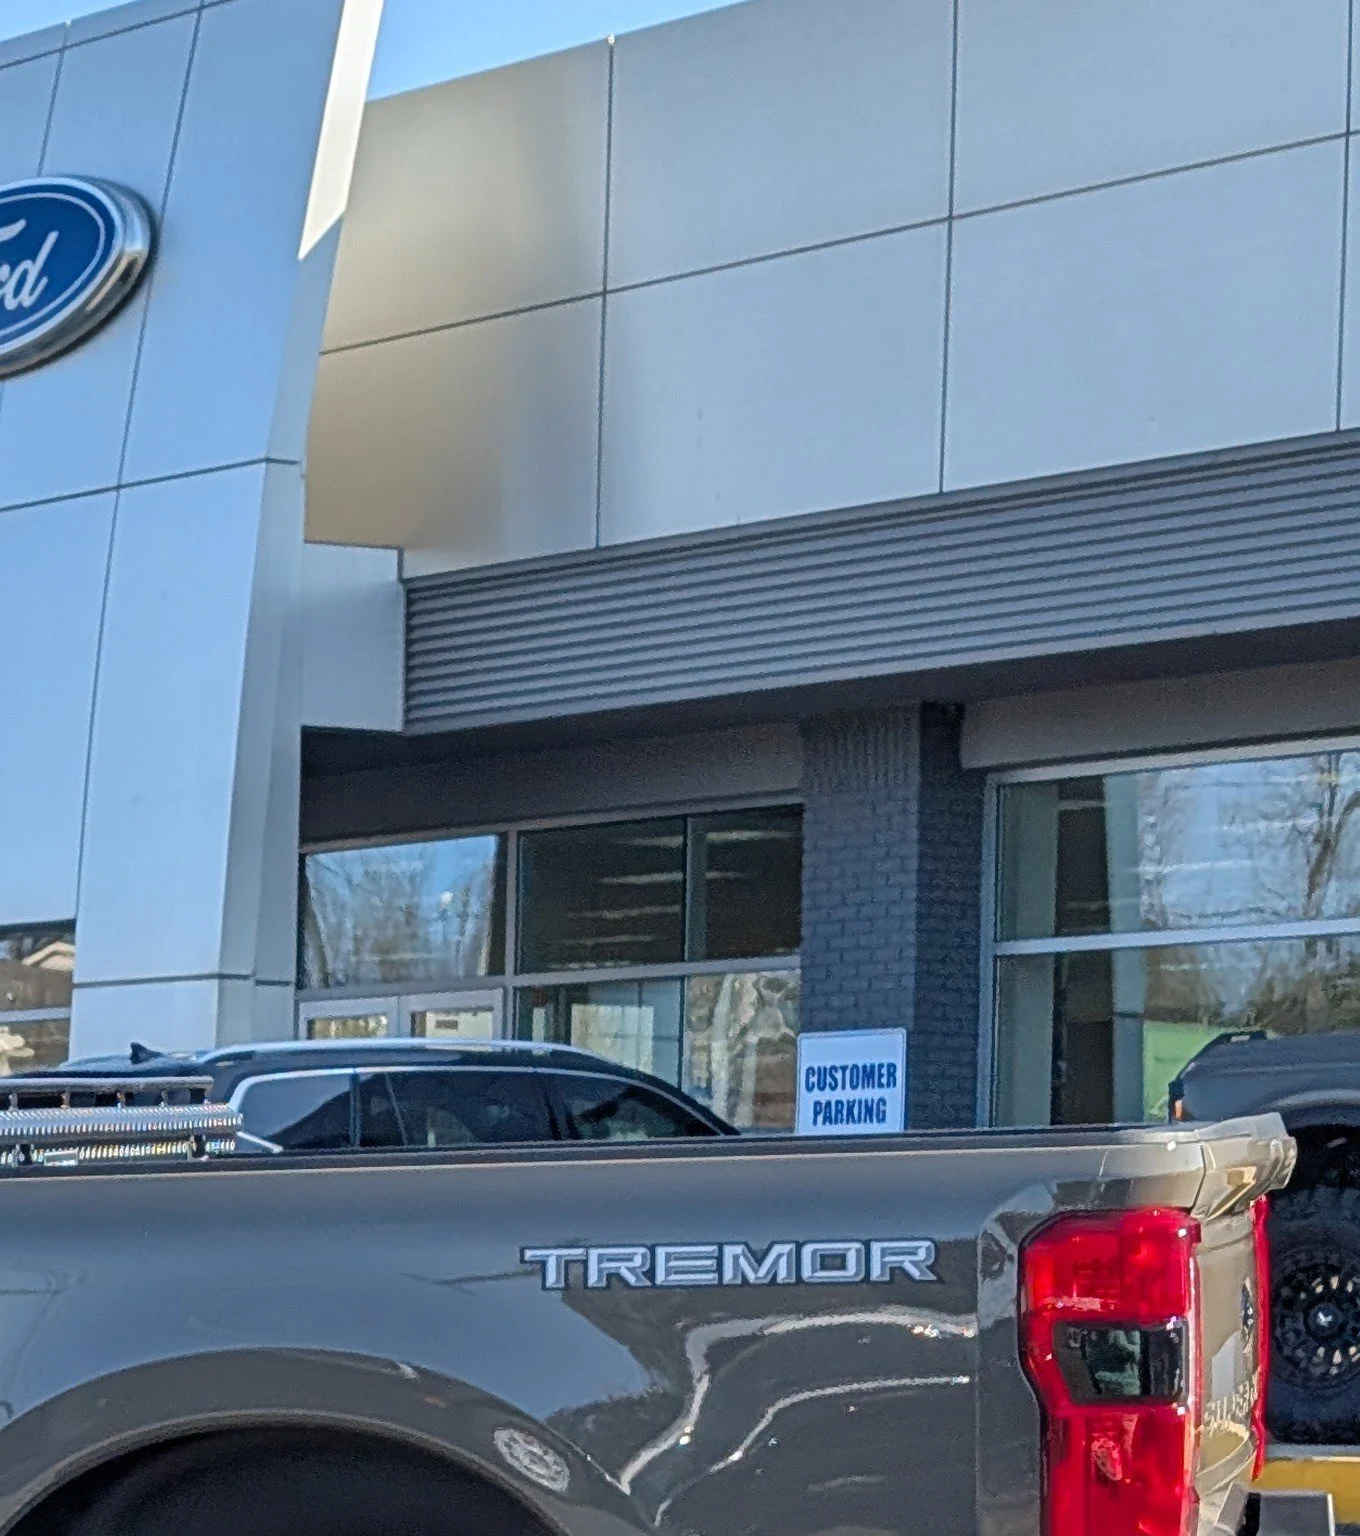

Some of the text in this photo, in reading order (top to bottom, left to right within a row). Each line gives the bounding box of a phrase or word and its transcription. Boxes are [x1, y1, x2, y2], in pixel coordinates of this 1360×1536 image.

[804, 1062, 897, 1092] CUSTOMER
[812, 1097, 887, 1127] PARKING
[520, 1239, 943, 1291] TREMOR
